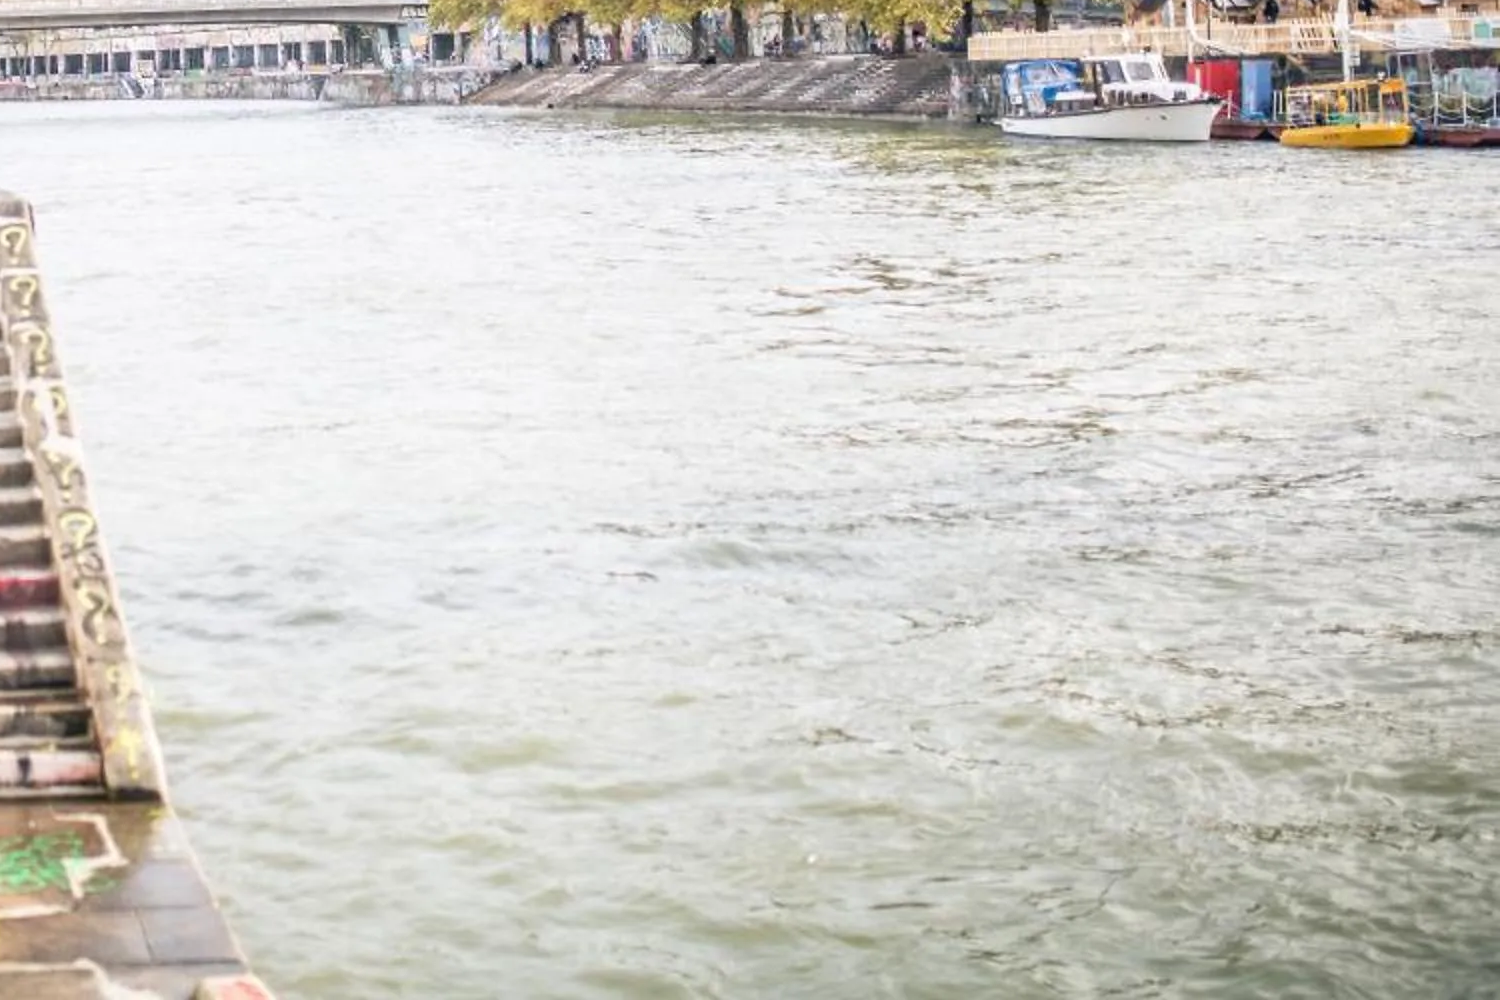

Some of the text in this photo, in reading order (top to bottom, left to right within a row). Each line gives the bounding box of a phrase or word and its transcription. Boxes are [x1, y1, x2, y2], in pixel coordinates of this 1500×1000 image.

[0, 226, 27, 265] ?
[8, 276, 38, 317] ?
[20, 328, 49, 375] ?
[59, 511, 95, 566] ?
